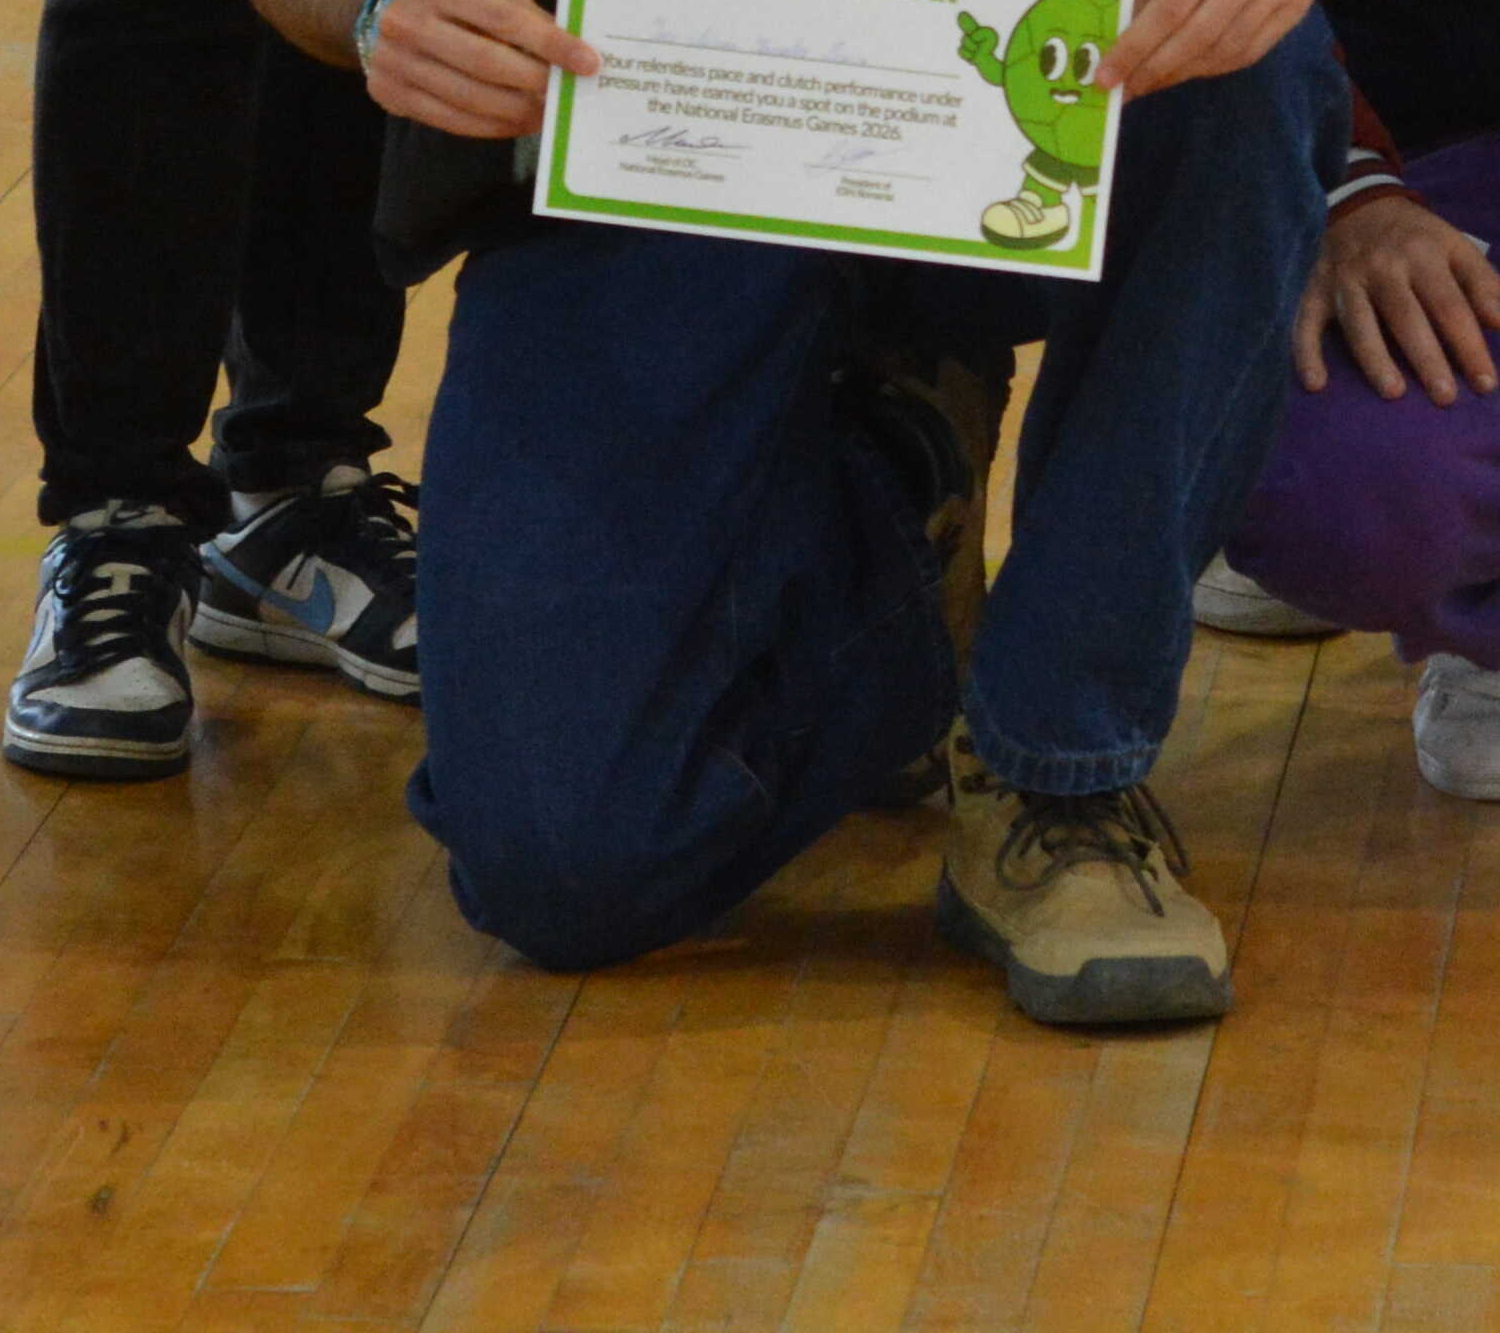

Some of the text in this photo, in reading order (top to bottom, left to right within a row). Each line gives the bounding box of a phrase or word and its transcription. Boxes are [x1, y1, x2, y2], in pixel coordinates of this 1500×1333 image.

[596, 68, 958, 128] pressure have earned you a spot on the podium at
[597, 50, 964, 108] Your relentless pace and clutch performance under
[646, 98, 673, 115] the
[674, 100, 739, 122] National
[740, 107, 804, 130] Erasmus
[804, 114, 858, 136] Games
